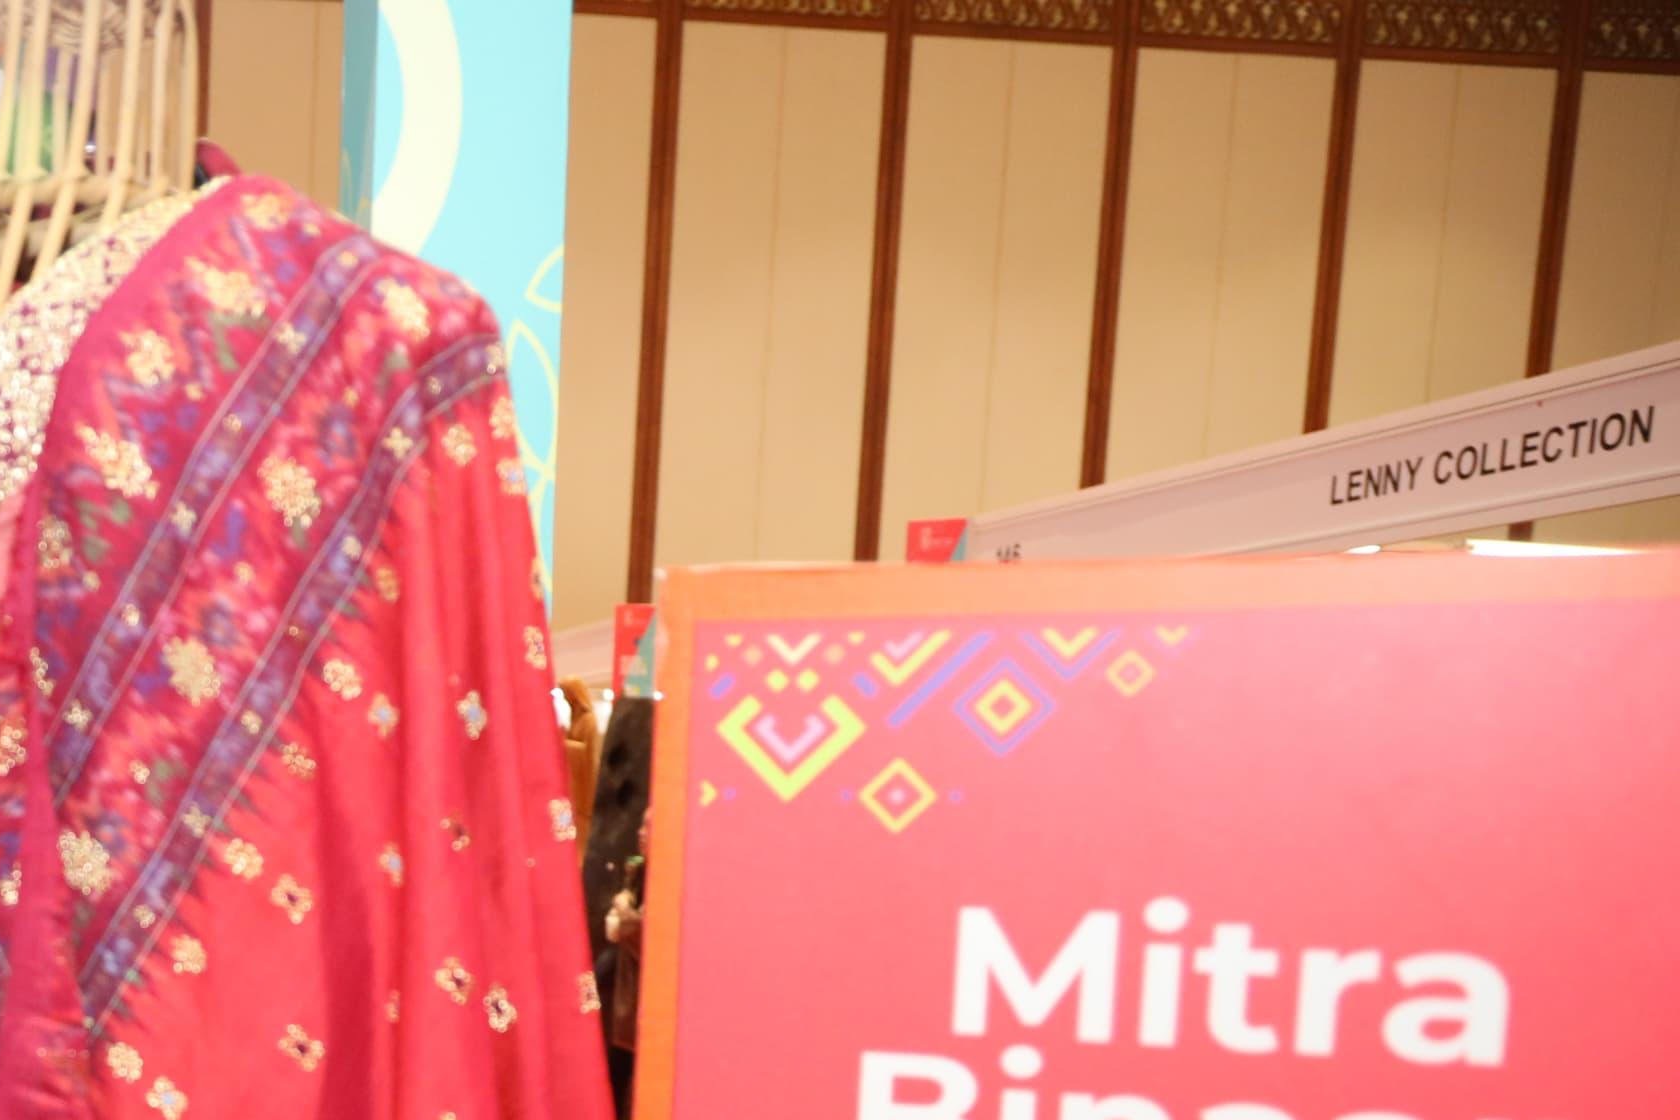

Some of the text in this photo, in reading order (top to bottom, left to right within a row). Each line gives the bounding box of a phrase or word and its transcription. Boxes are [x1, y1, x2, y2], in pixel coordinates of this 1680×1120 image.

[1330, 405, 1655, 506] LENNY COLLECTION
[951, 896, 1509, 1067] Mitra
